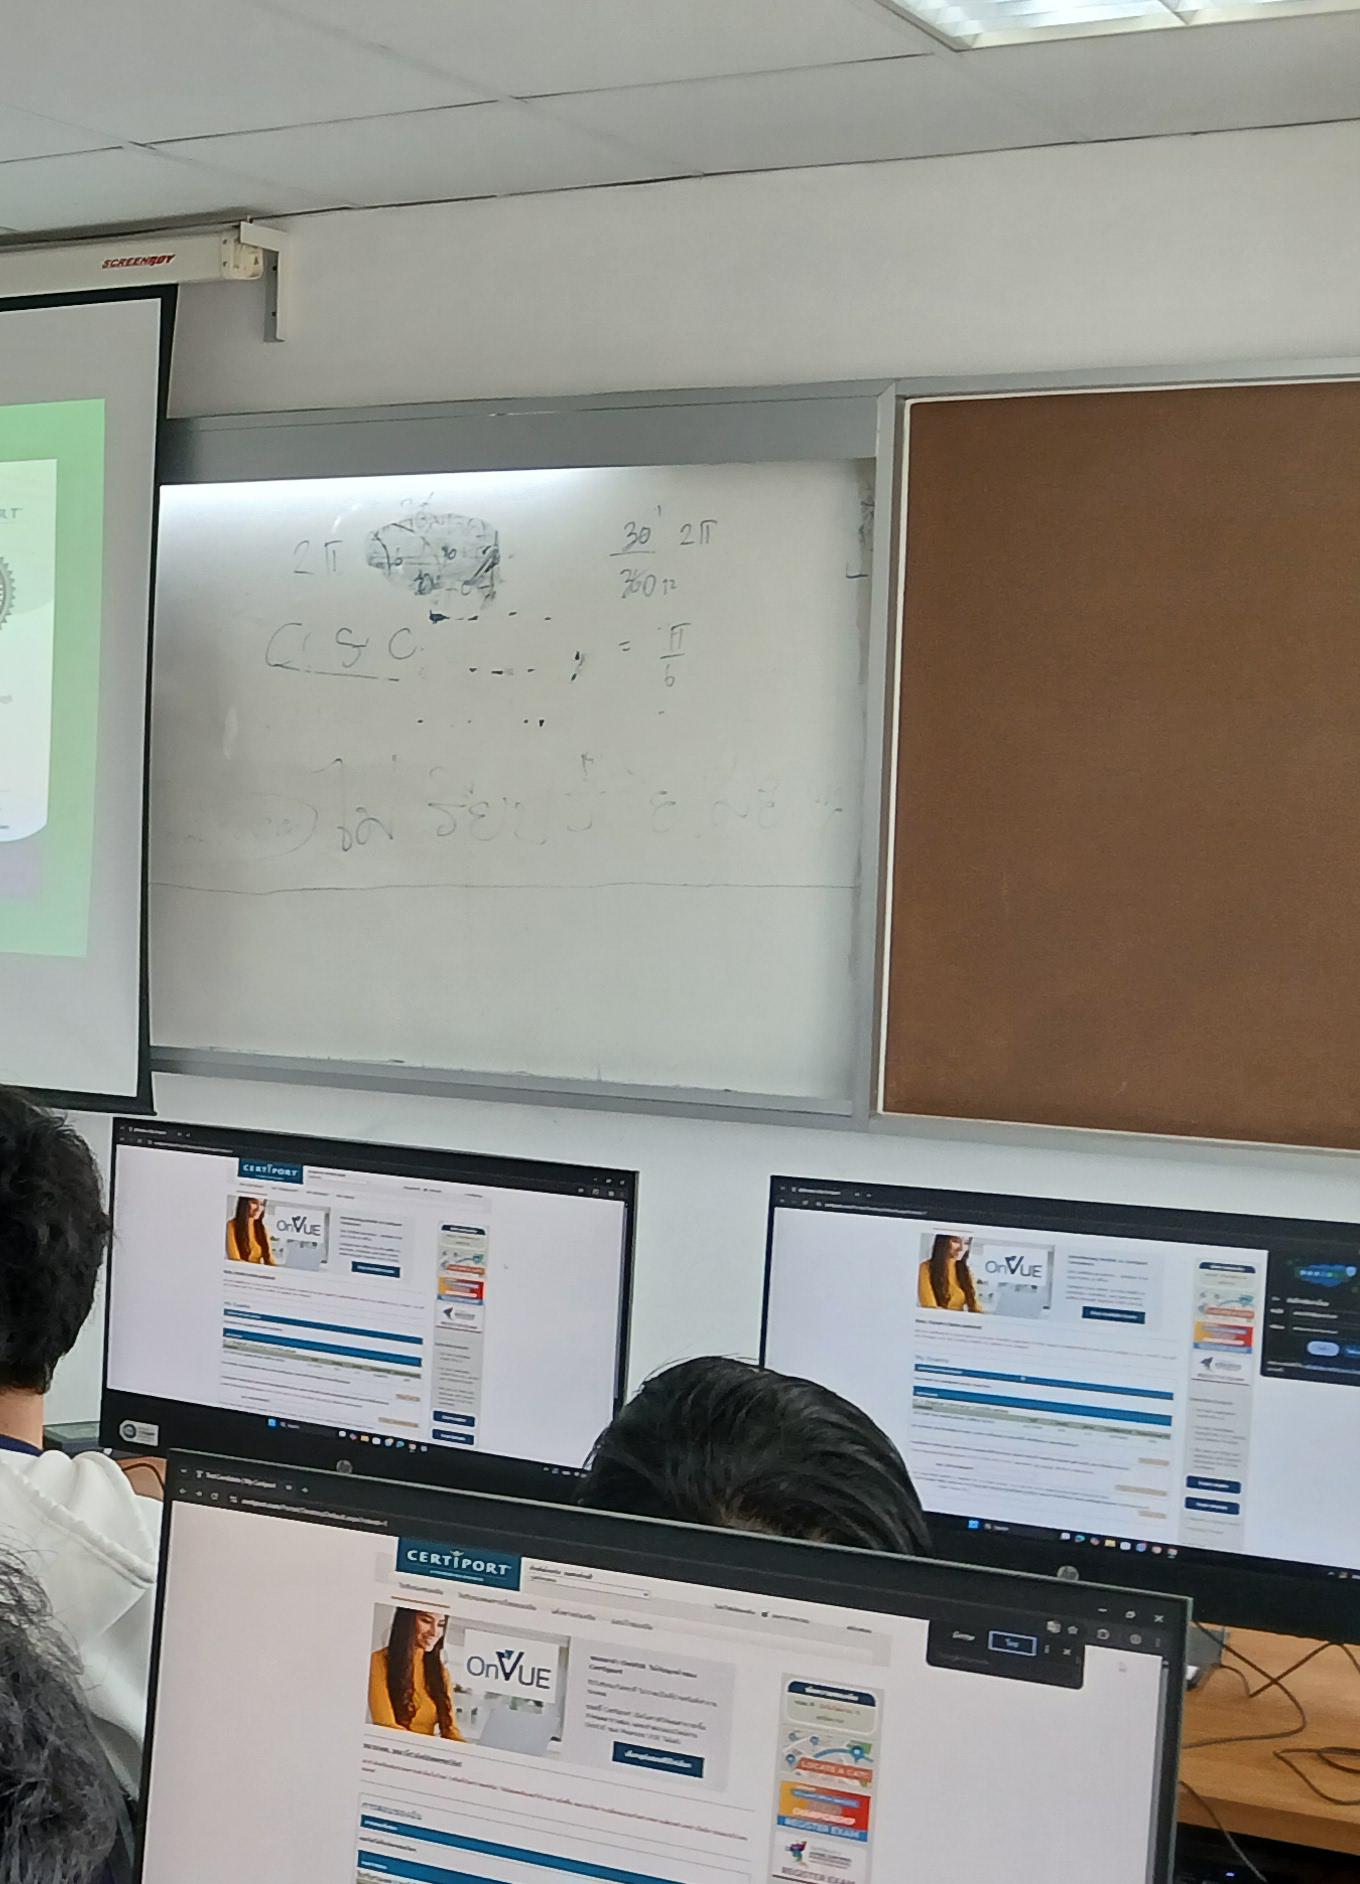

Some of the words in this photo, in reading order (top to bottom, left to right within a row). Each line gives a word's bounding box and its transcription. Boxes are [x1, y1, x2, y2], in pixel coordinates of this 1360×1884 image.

[276, 1215, 321, 1237] OnVUE
[984, 1255, 1043, 1278] OnVUE
[406, 1549, 512, 1577] CERTIPORT
[466, 1649, 552, 1690] OnVUE
